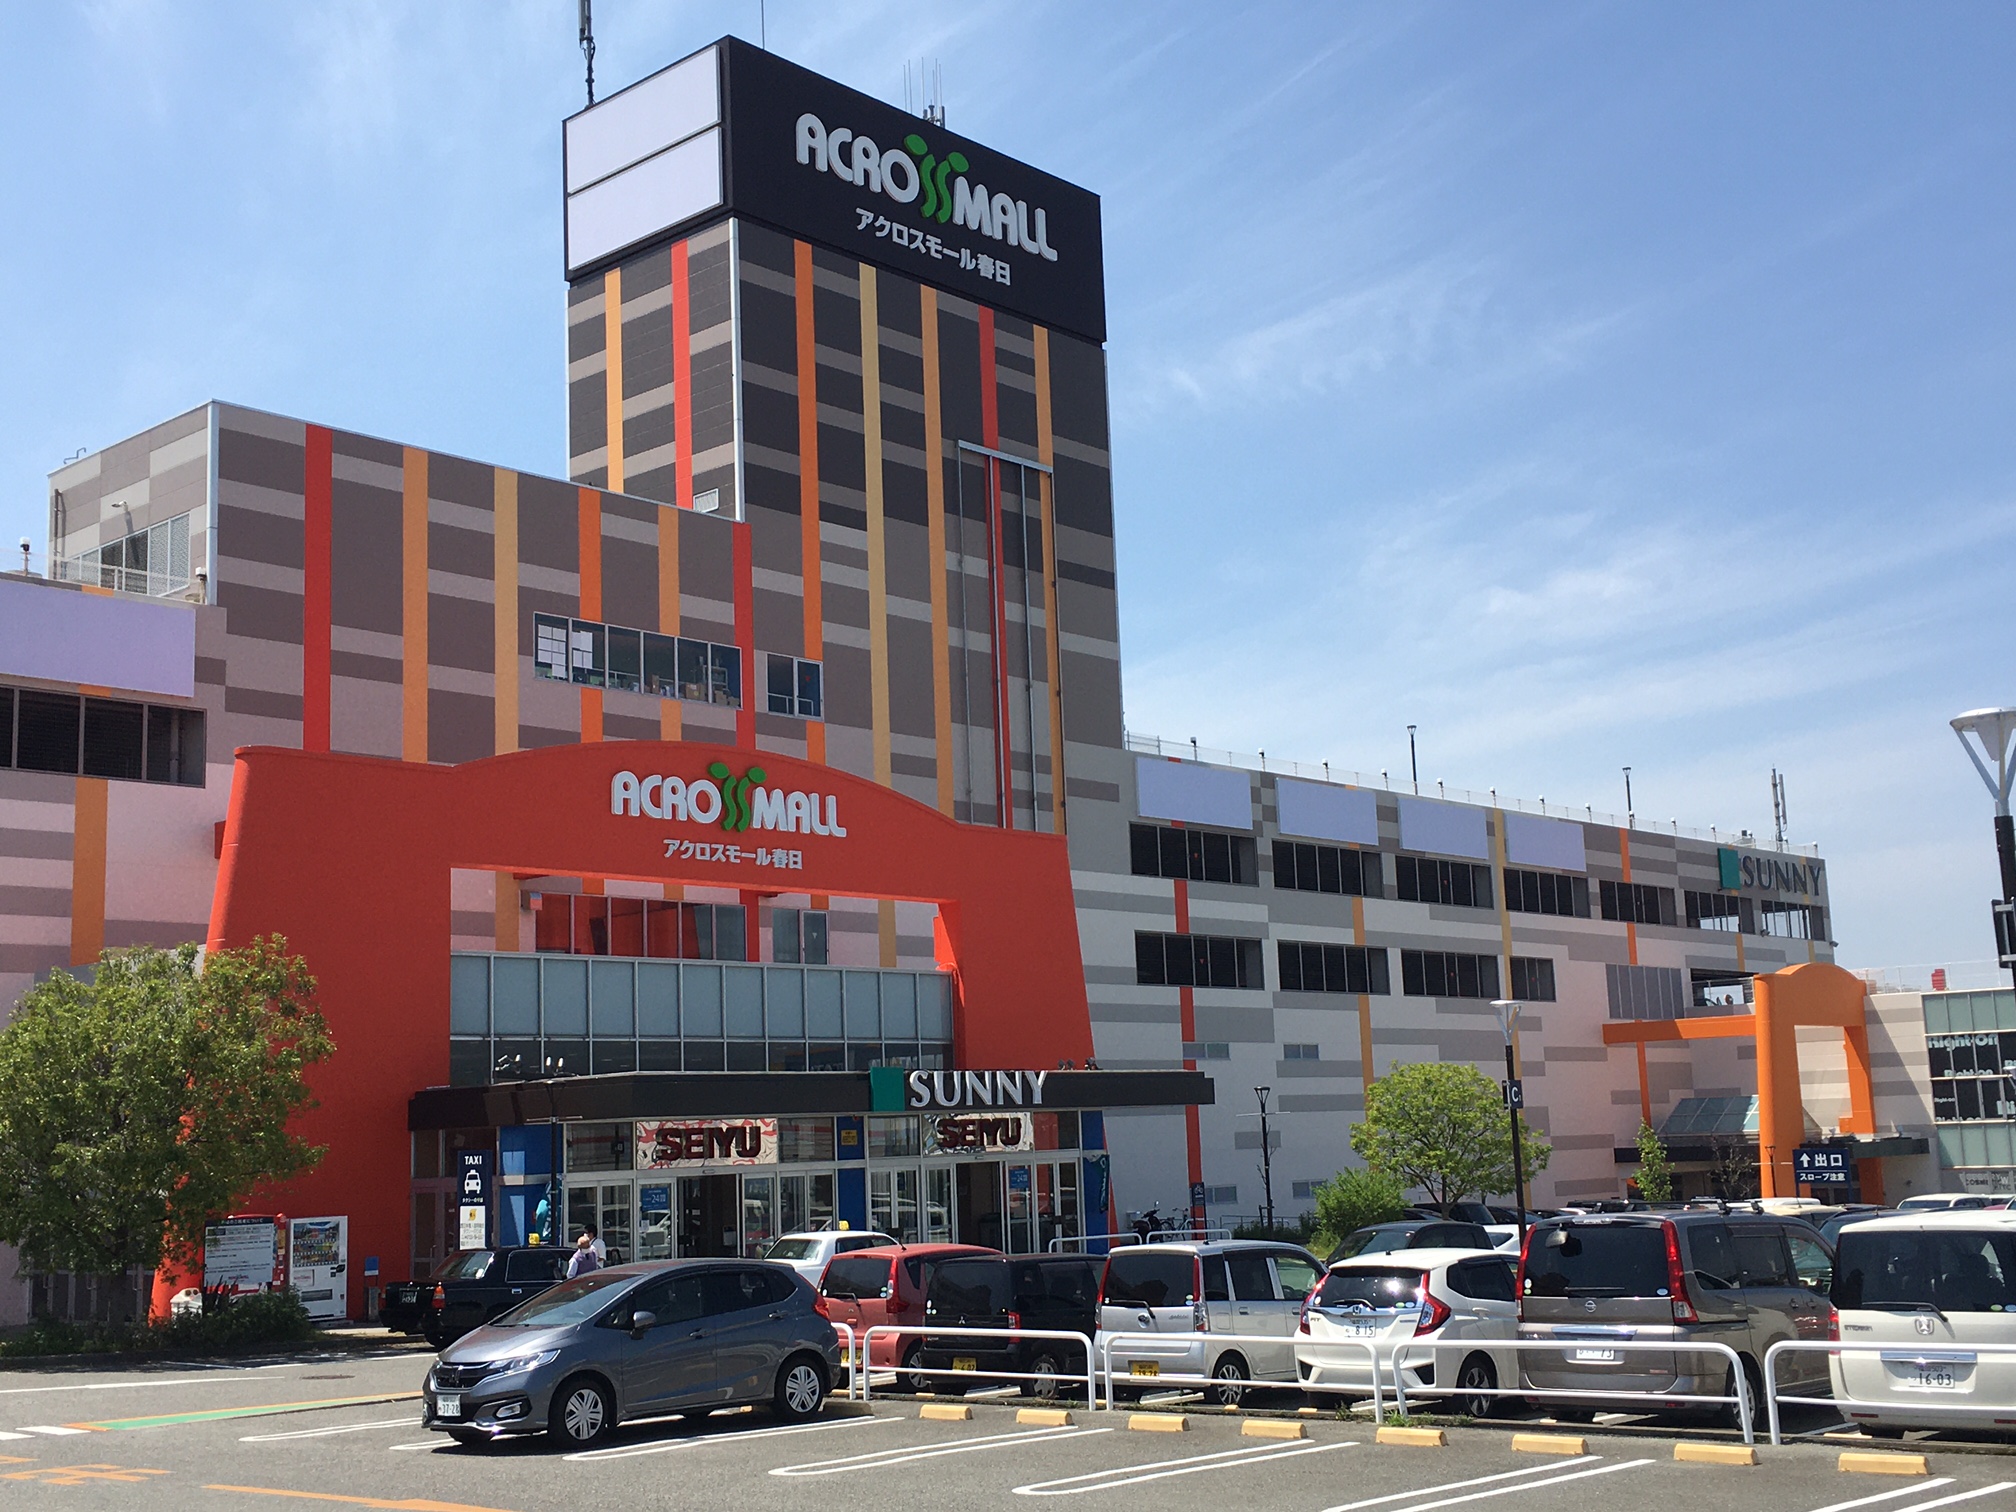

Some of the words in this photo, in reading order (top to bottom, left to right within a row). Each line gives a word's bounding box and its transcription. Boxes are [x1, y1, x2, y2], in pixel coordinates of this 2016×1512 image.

[855, 207, 1011, 286] アクロスモール春日
[663, 839, 803, 869] アクロスモール春日
[1742, 855, 1820, 896] SUNNY
[909, 1070, 1049, 1107] SUNNY
[654, 1126, 761, 1160] SEIYU
[937, 1117, 1022, 1148] SEIYU
[464, 1155, 483, 1165] TAXI
[1814, 1152, 1843, 1167] 出口
[1799, 1172, 1846, 1181] スロープ注意
[1919, 1372, 1952, 1386] 16-03
